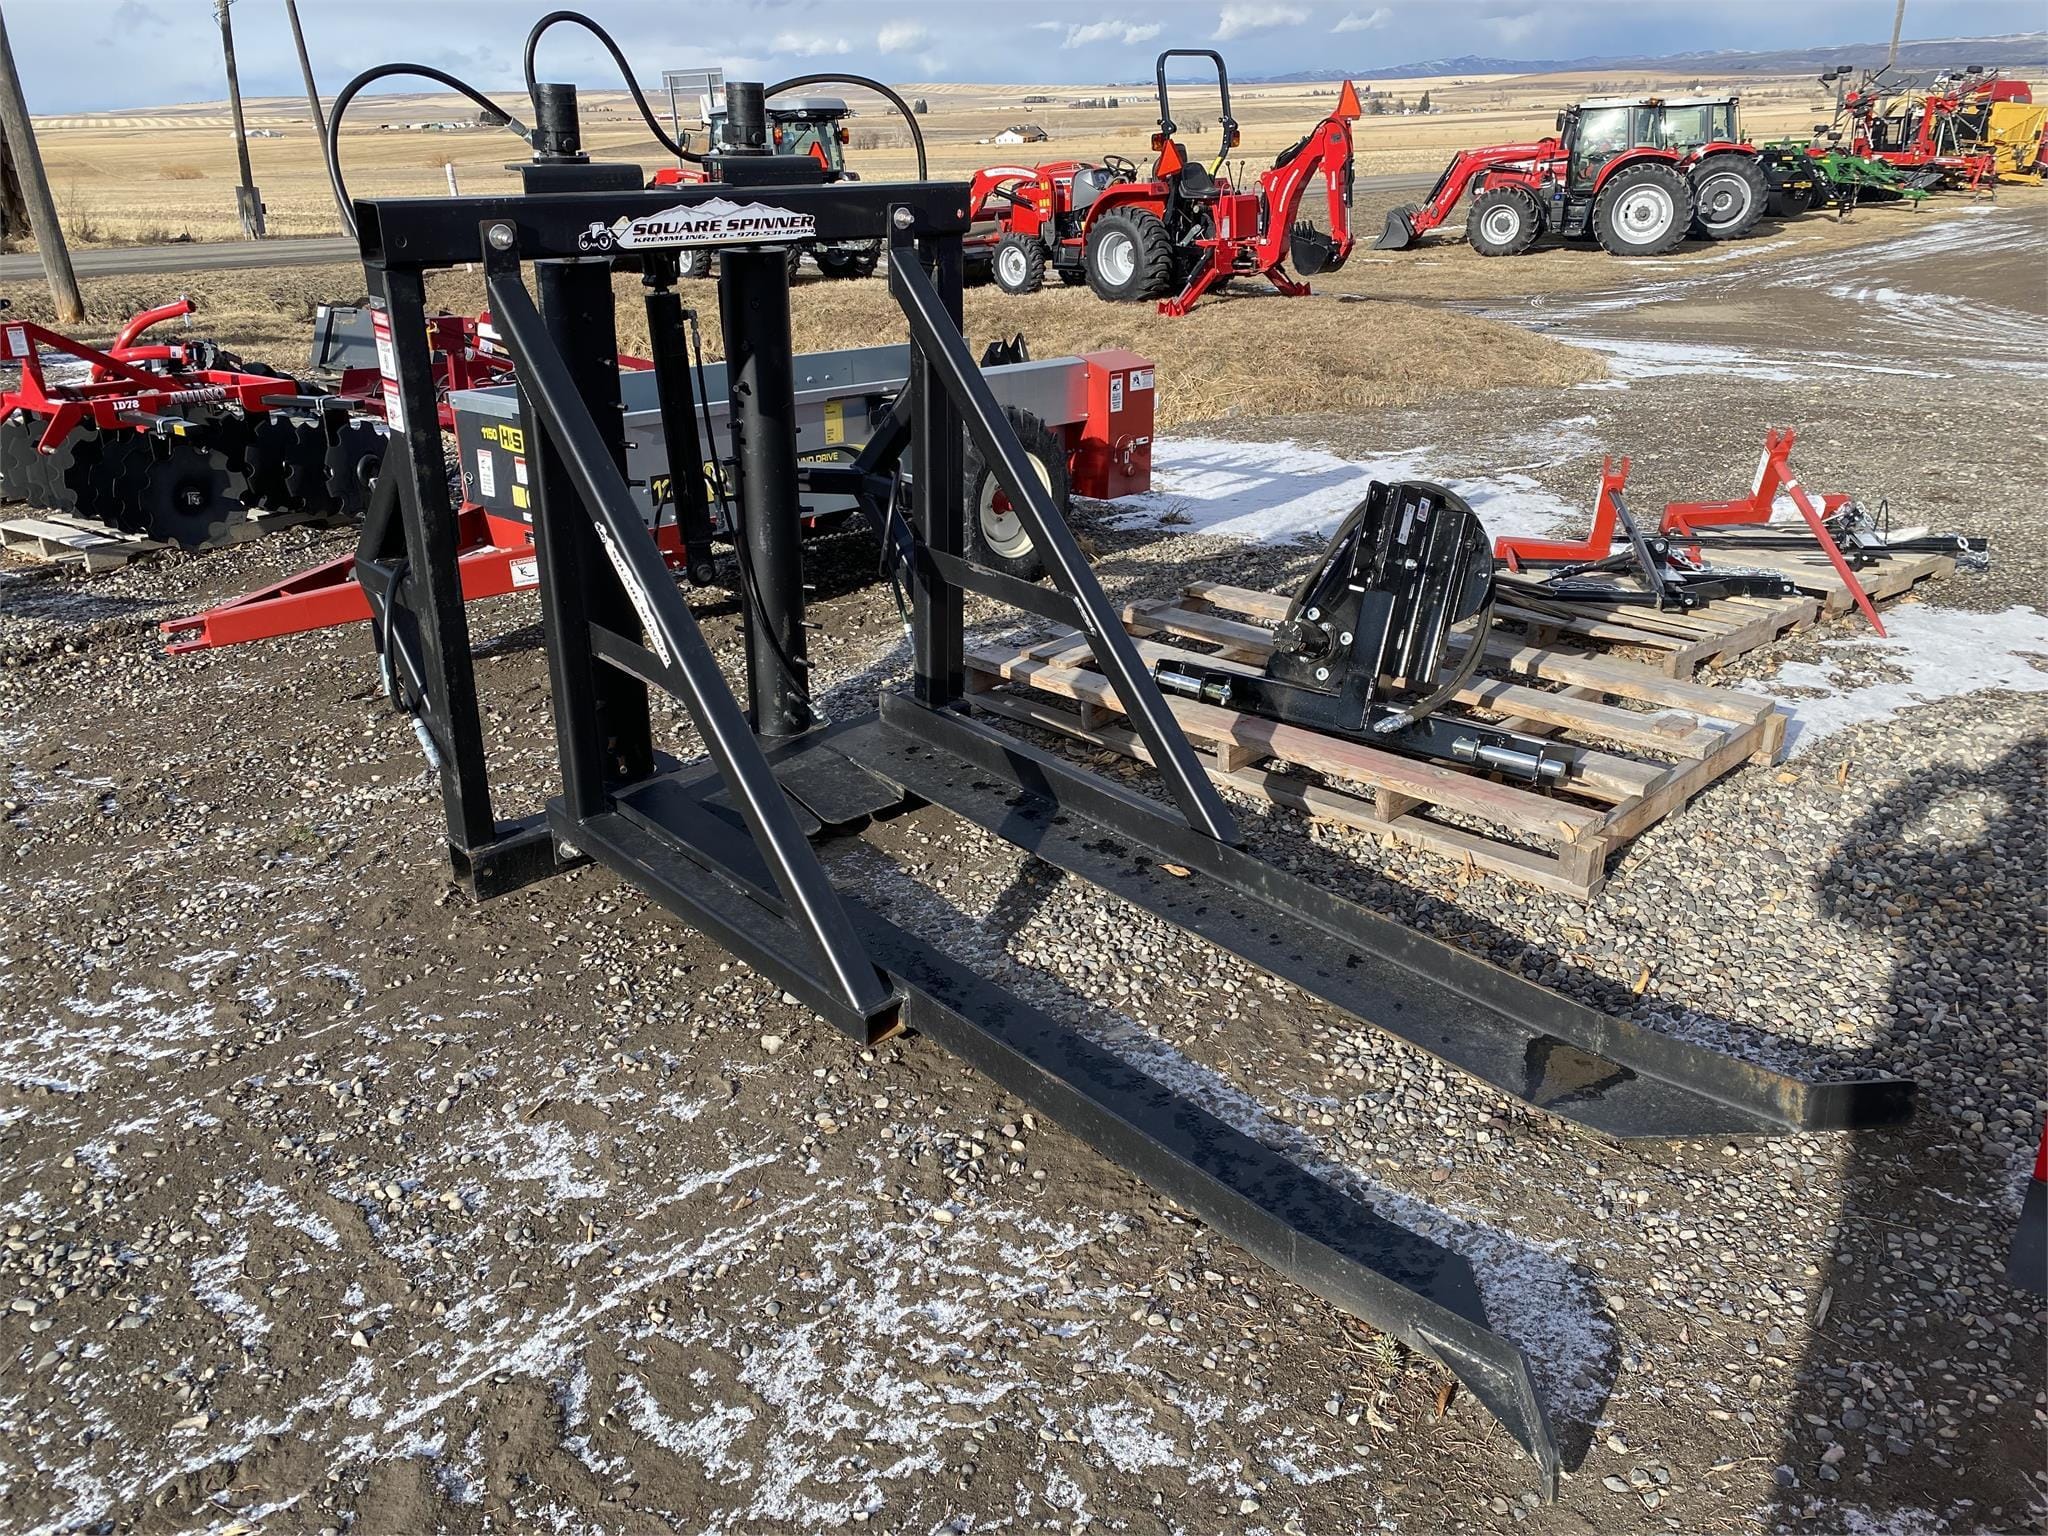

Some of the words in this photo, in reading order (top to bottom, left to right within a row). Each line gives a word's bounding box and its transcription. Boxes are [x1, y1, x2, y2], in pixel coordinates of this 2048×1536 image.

[632, 219, 722, 236] SQUARE
[727, 216, 816, 231] SPINNER
[633, 234, 709, 243] KREMMLING,
[170, 388, 226, 405] RHINO
[815, 452, 839, 463] DRIVE
